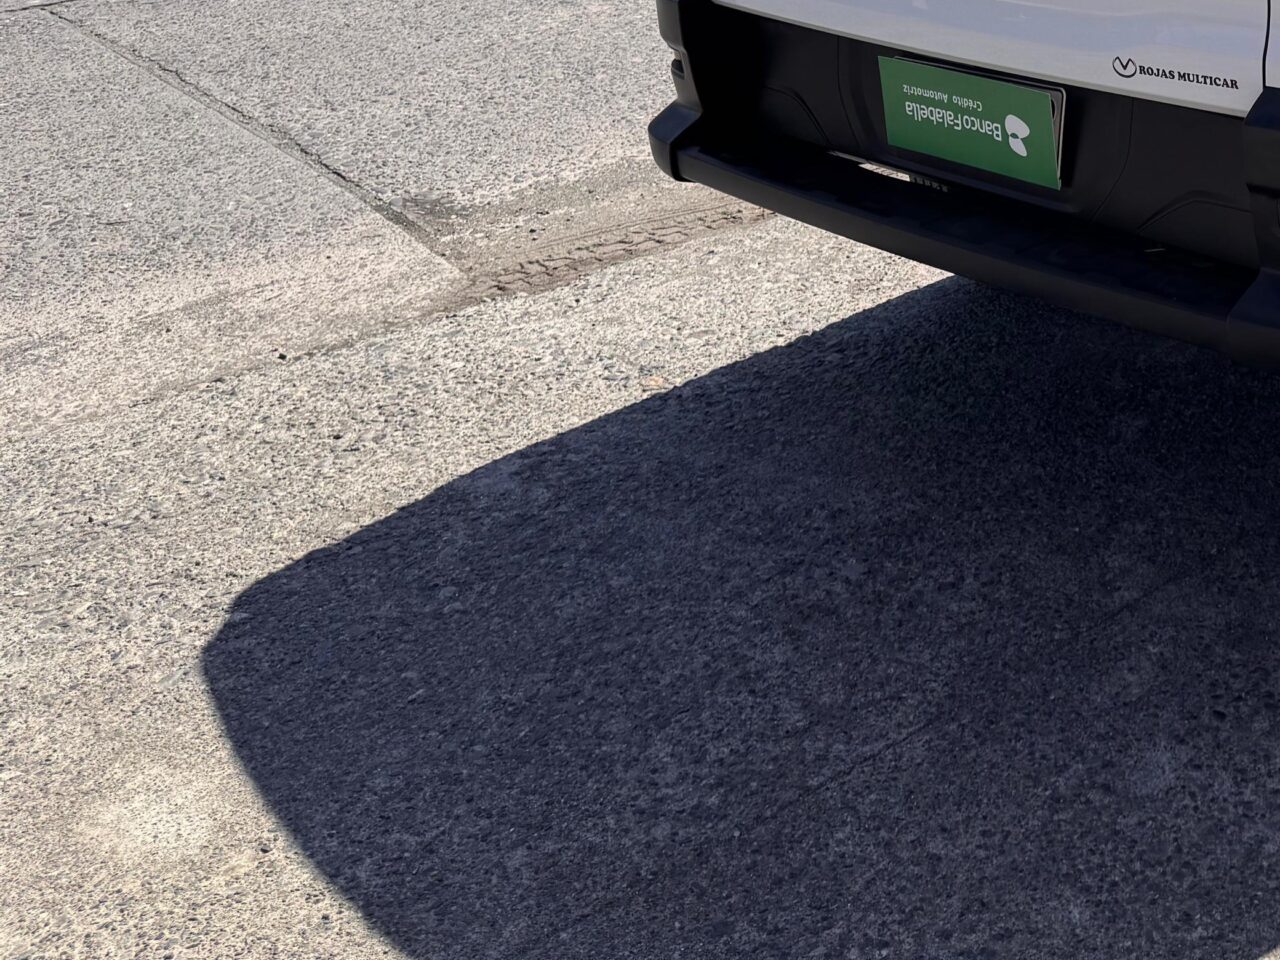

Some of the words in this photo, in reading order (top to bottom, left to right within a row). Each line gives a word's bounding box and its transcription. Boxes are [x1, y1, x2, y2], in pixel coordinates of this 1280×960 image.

[1138, 65, 1176, 80] ROJAS
[1177, 71, 1240, 90] MULTICAR
[902, 84, 949, 104] Automotriz
[952, 94, 983, 113] Crédito
